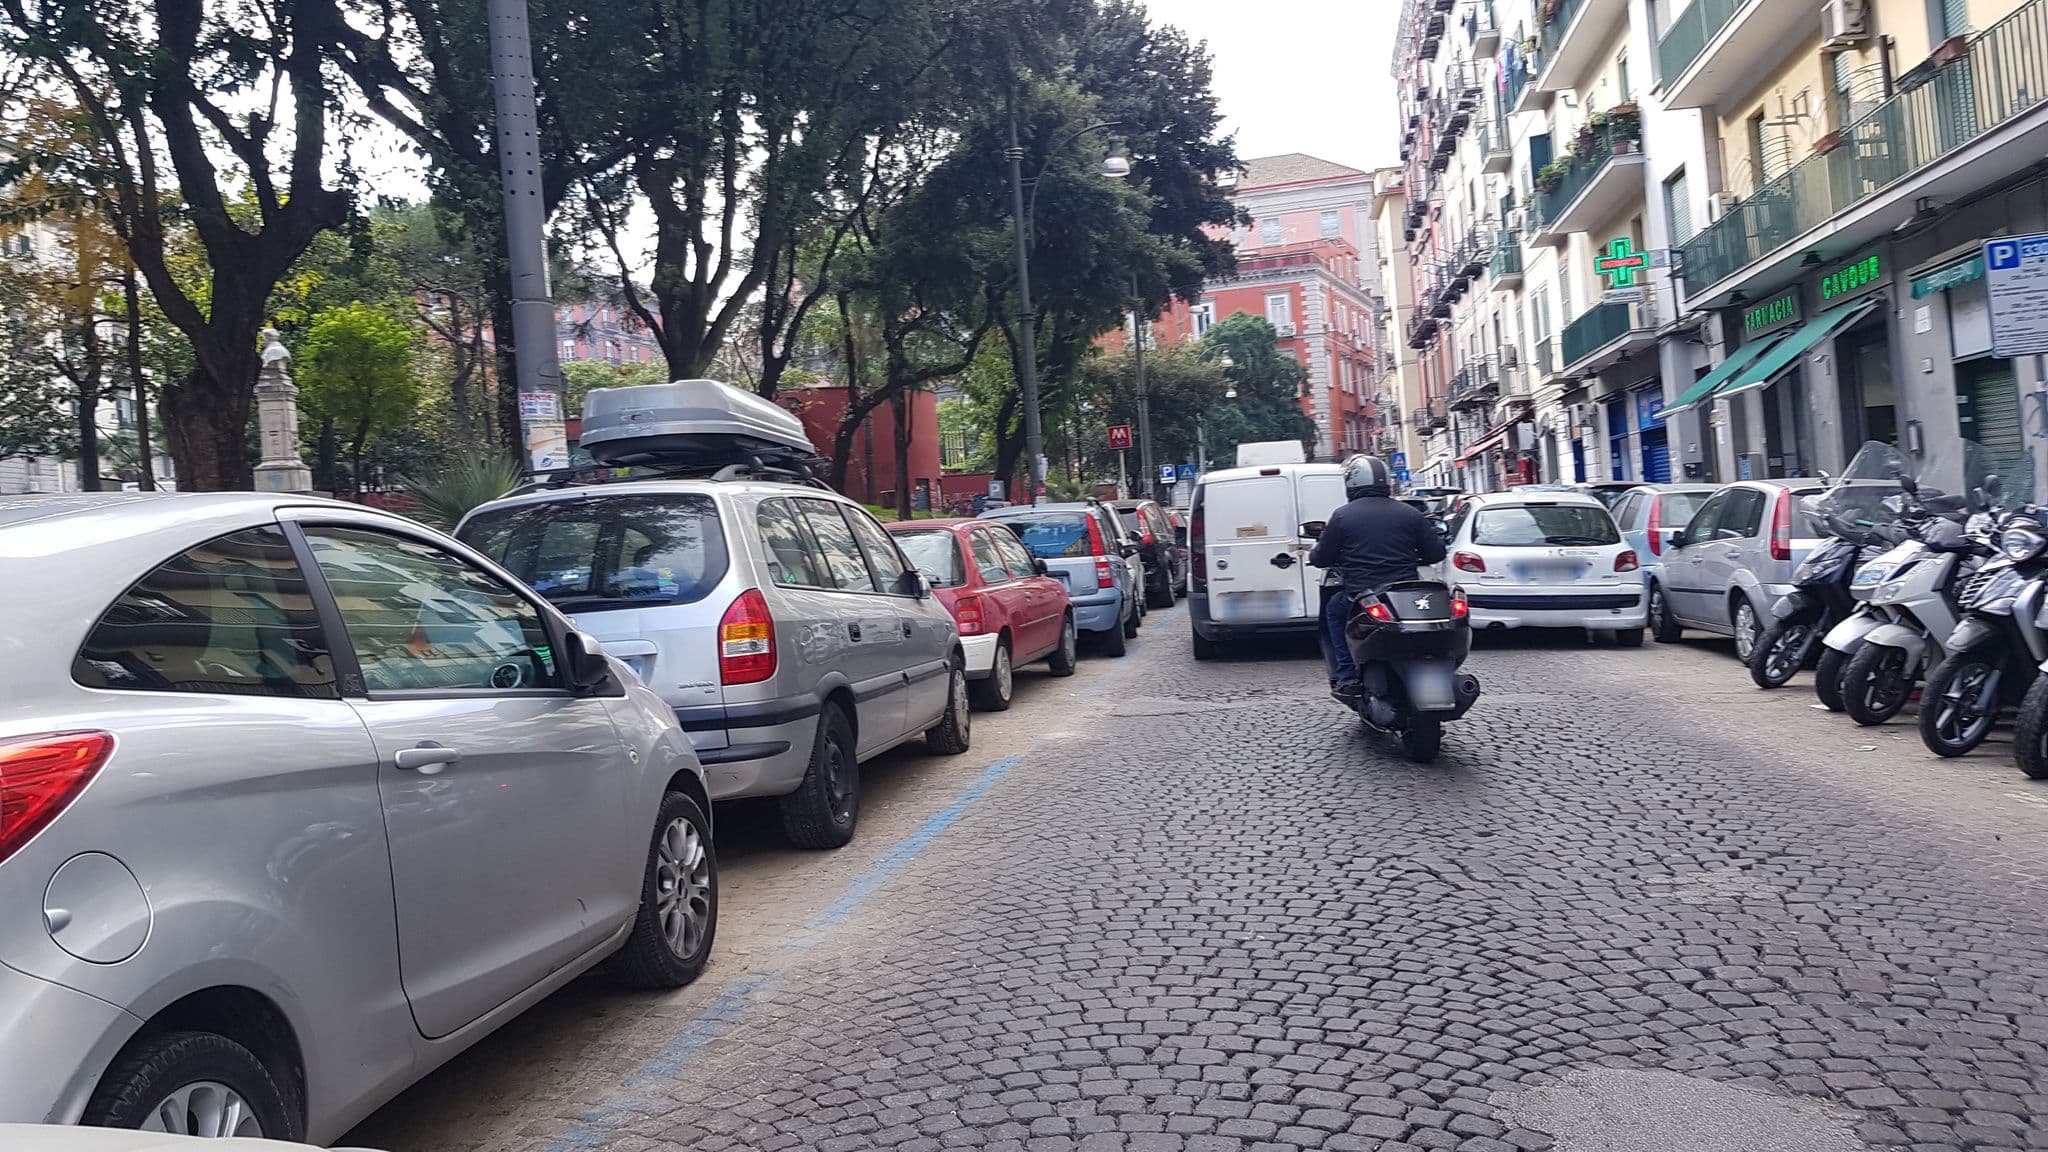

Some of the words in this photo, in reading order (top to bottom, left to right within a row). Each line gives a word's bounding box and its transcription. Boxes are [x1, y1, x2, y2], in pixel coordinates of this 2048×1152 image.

[1993, 244, 2014, 267] P
[1744, 296, 1793, 333] FARMACIA
[1822, 256, 1880, 299] CAVOUR
[1111, 428, 1127, 440] M
[1162, 466, 1172, 477] P
